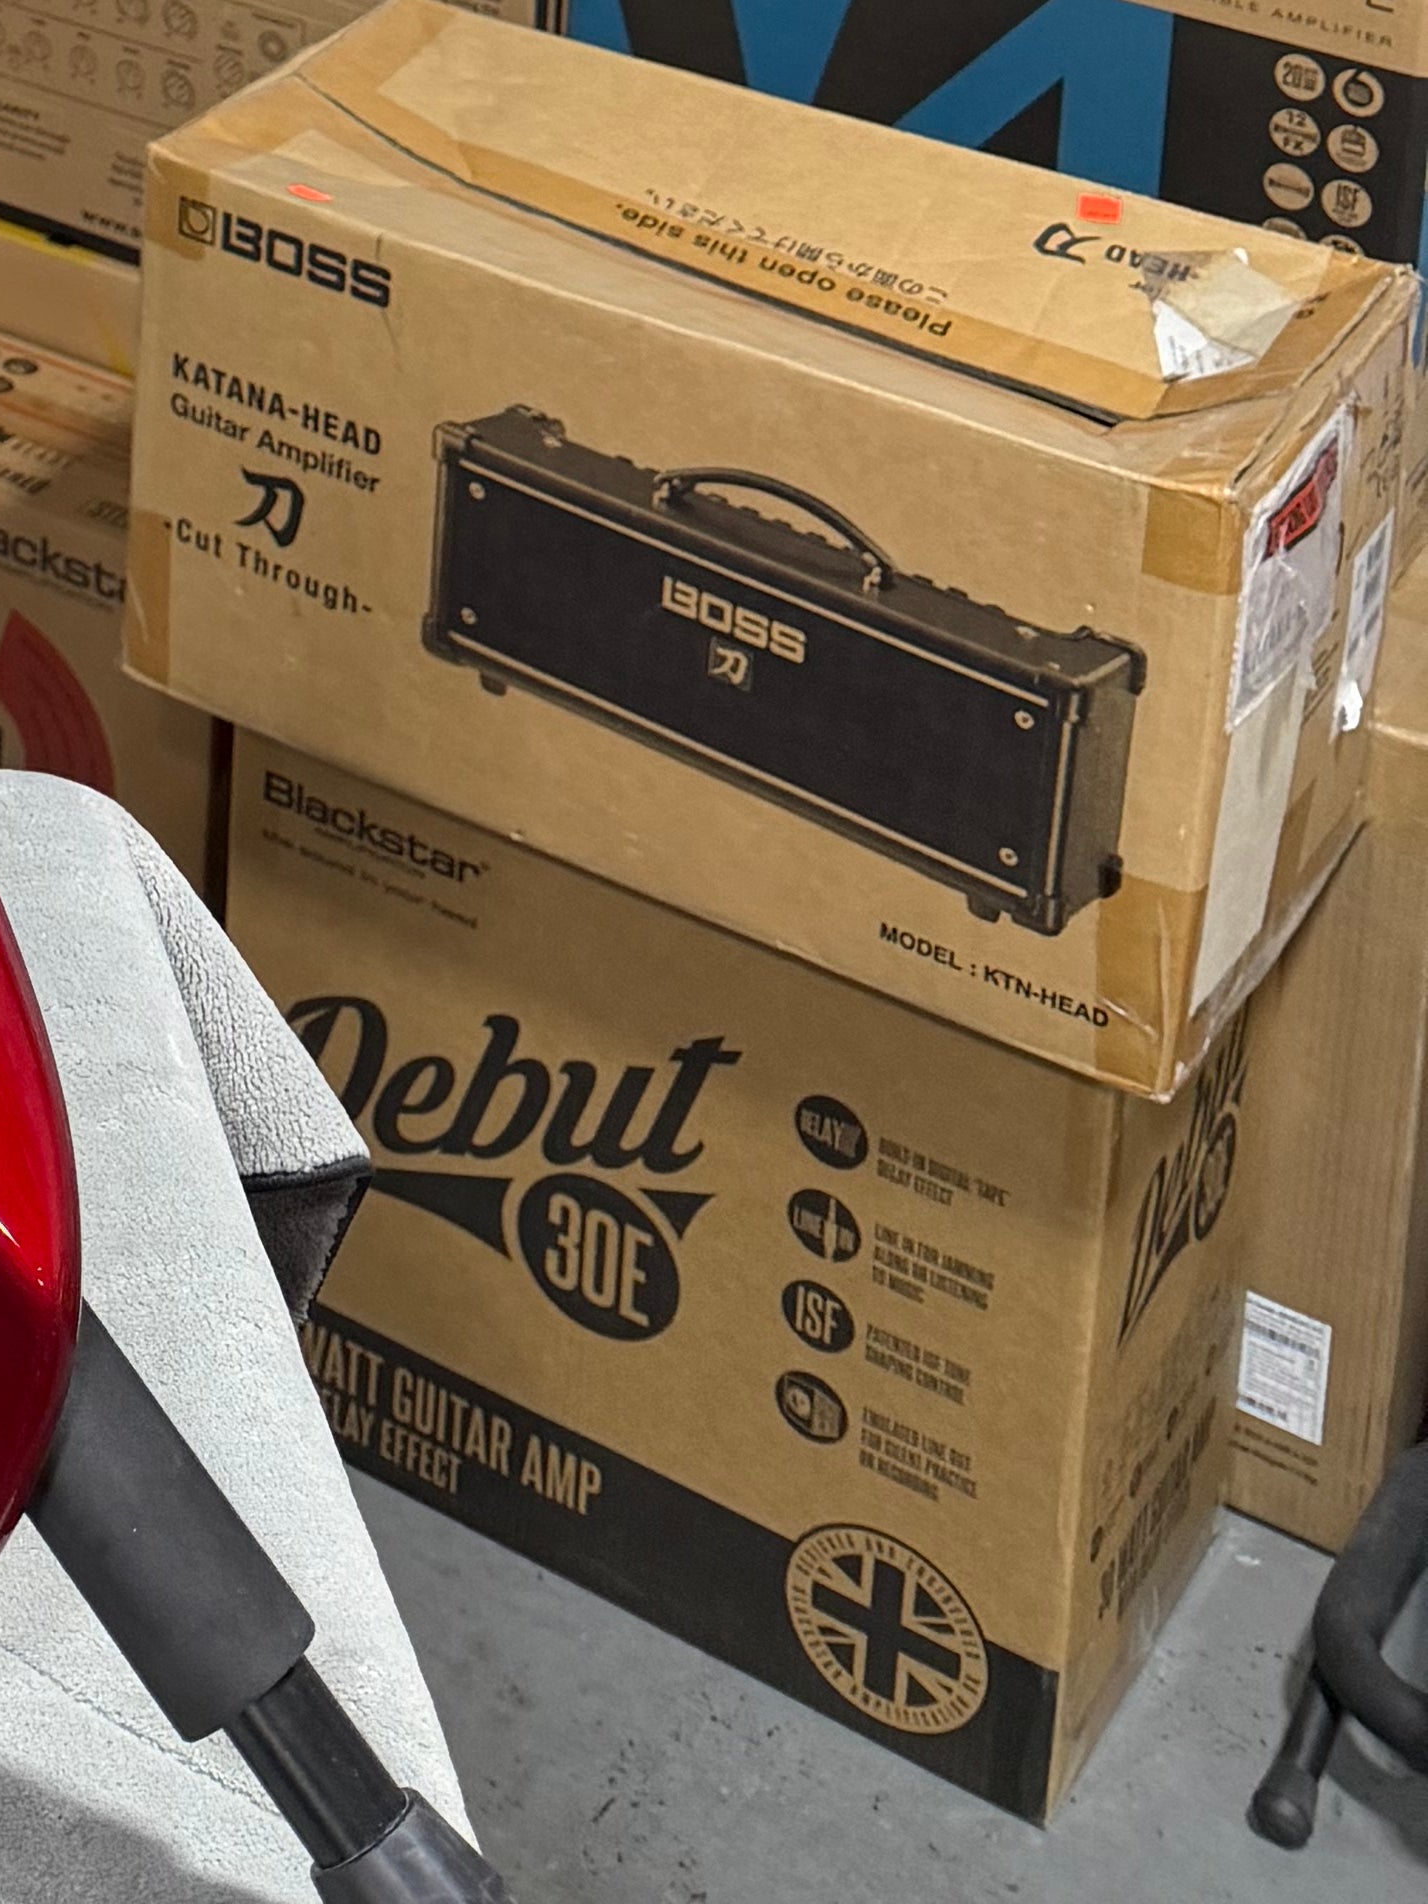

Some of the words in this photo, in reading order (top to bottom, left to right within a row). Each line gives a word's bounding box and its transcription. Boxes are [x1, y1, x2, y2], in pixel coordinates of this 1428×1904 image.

[1270, 7, 1394, 48] AMPLIFIER
[219, 210, 393, 309] BOSS
[694, 233, 751, 266] this
[760, 256, 836, 293] open
[845, 285, 953, 339] Please
[169, 392, 251, 445] Guitar
[256, 429, 382, 496] Amplifier
[171, 351, 383, 456] KATANA-HEAD
[232, 468, 306, 549] 刀
[660, 574, 807, 666] BOSS
[261, 769, 482, 883] Blackstar
[877, 920, 964, 976] MODEL
[981, 965, 1111, 1031] KTN-HEAD
[282, 992, 742, 1175] Debut
[544, 1192, 653, 1329] 30E
[795, 1284, 843, 1345] ISF
[379, 1413, 463, 1493] EFFECT
[393, 1365, 513, 1477] GUITAR
[521, 1433, 603, 1516] AMP
